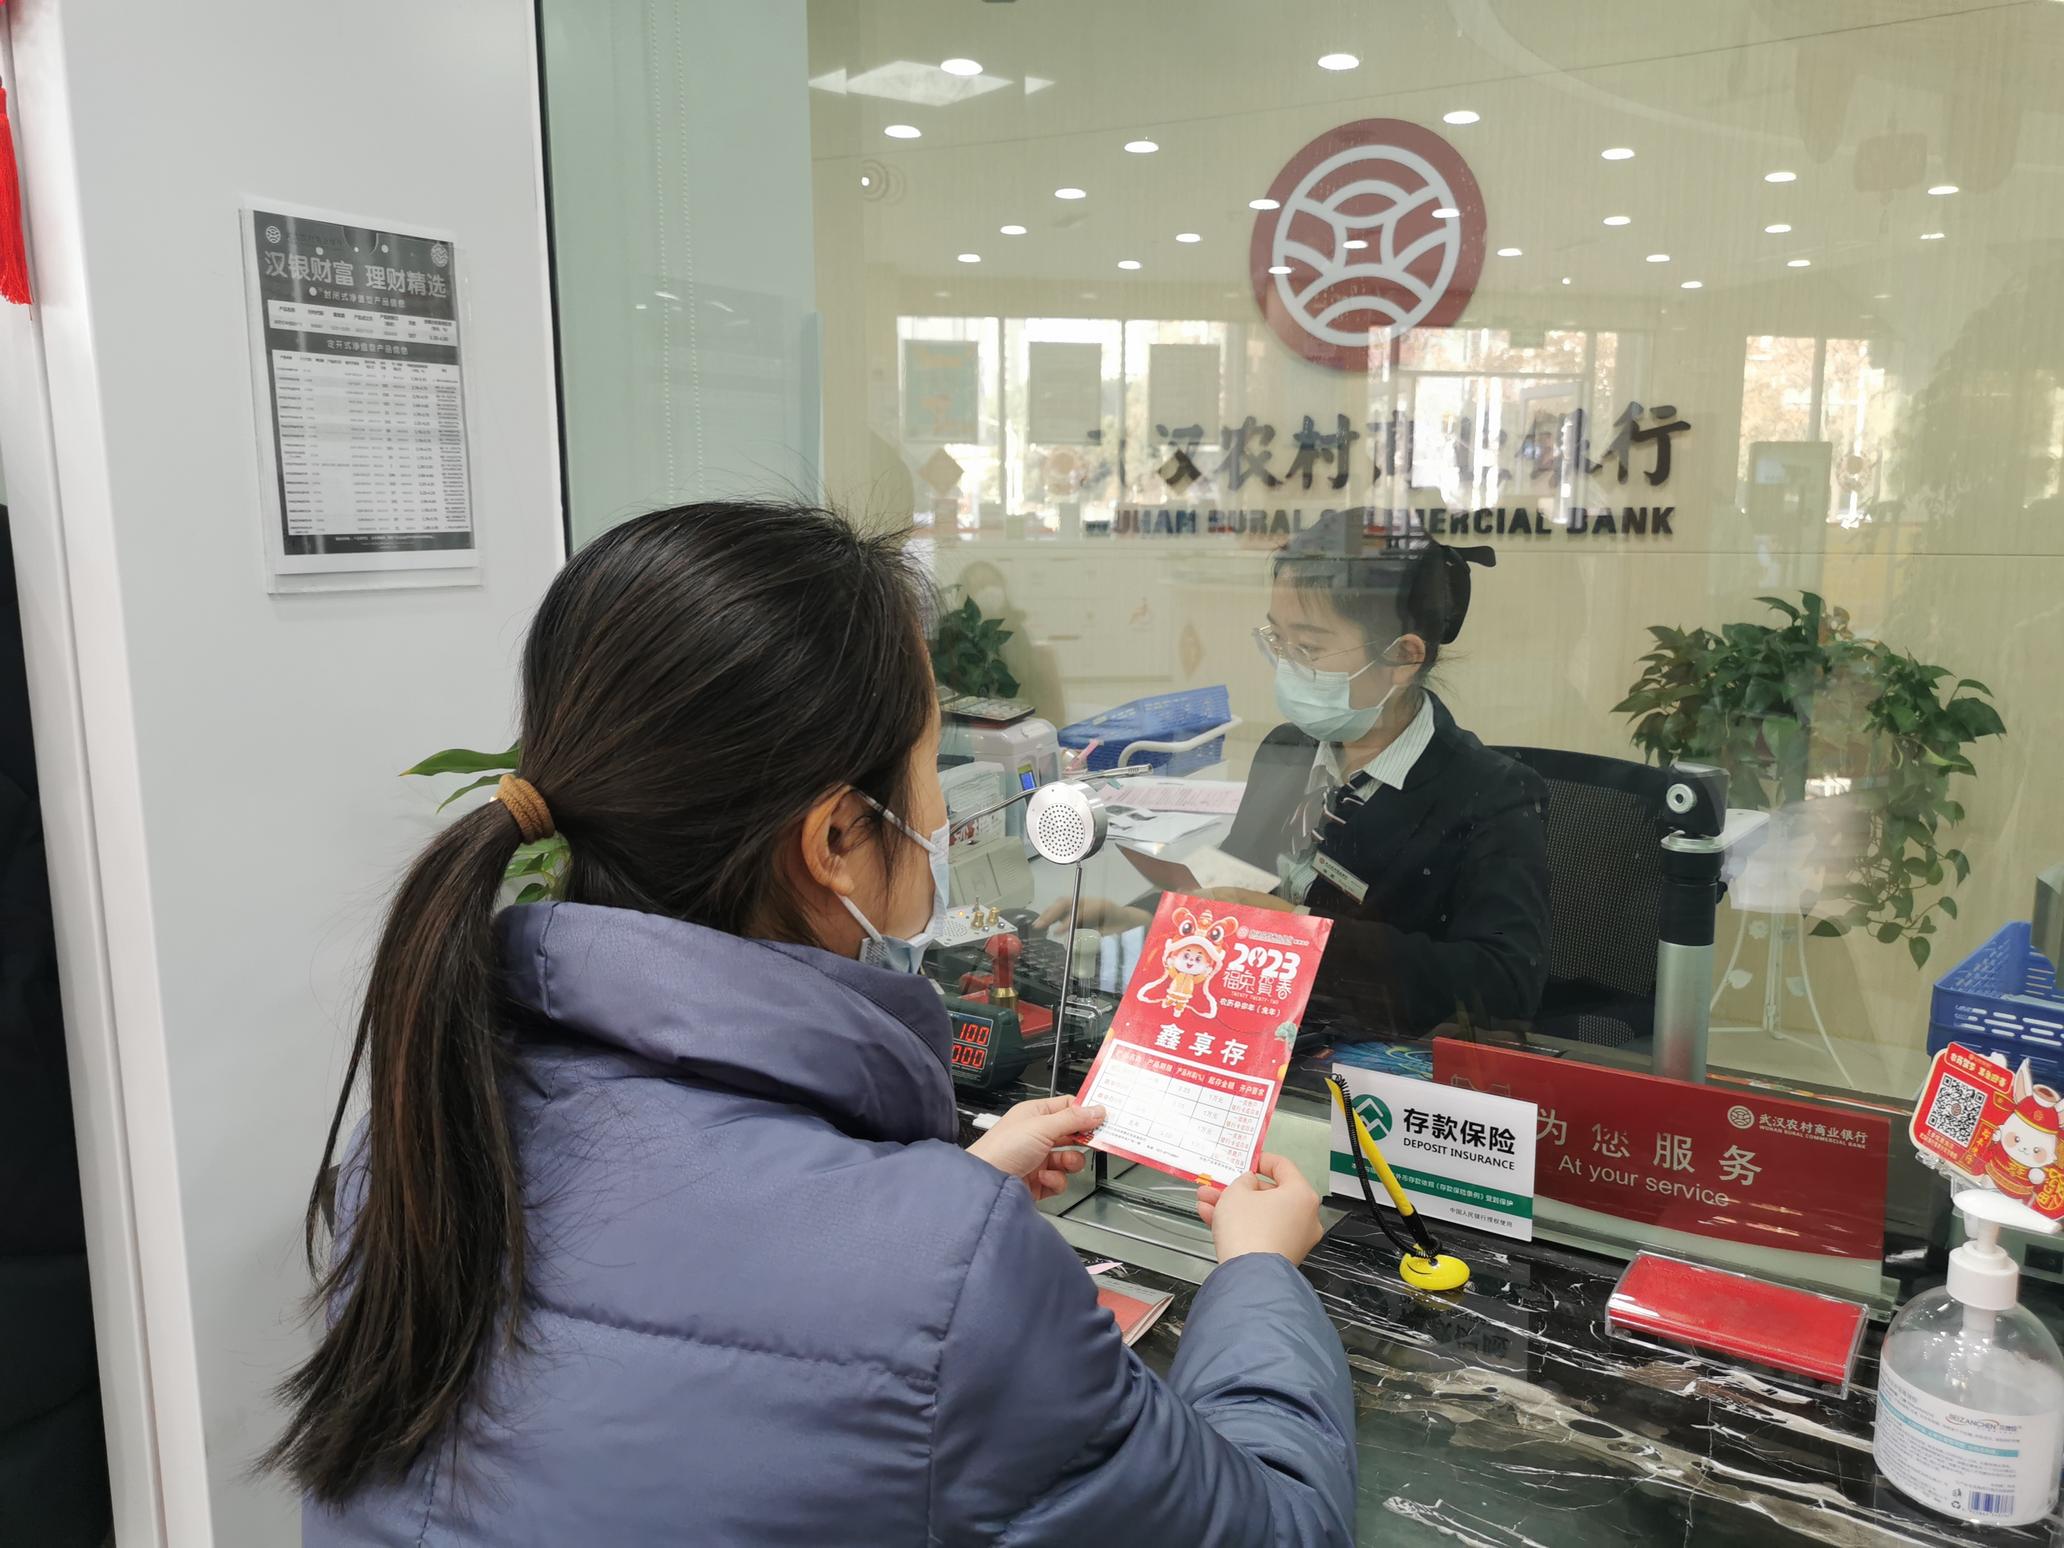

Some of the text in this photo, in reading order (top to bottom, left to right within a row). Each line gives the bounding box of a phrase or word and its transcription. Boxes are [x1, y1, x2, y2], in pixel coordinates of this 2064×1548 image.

[264, 250, 447, 299] 汉银财富 理财精选
[1566, 507, 1675, 535] BANK
[1226, 942, 1301, 981] 2023
[960, 1023, 990, 1045] 100
[1153, 1022, 1248, 1066] 鑫享存
[1403, 1107, 1516, 1156] 存款保险
[1759, 1113, 1868, 1144] 武汉农村商业银行
[1403, 1137, 1516, 1171] DEPOSIT INSURANCE
[1557, 1154, 1729, 1207] At your service
